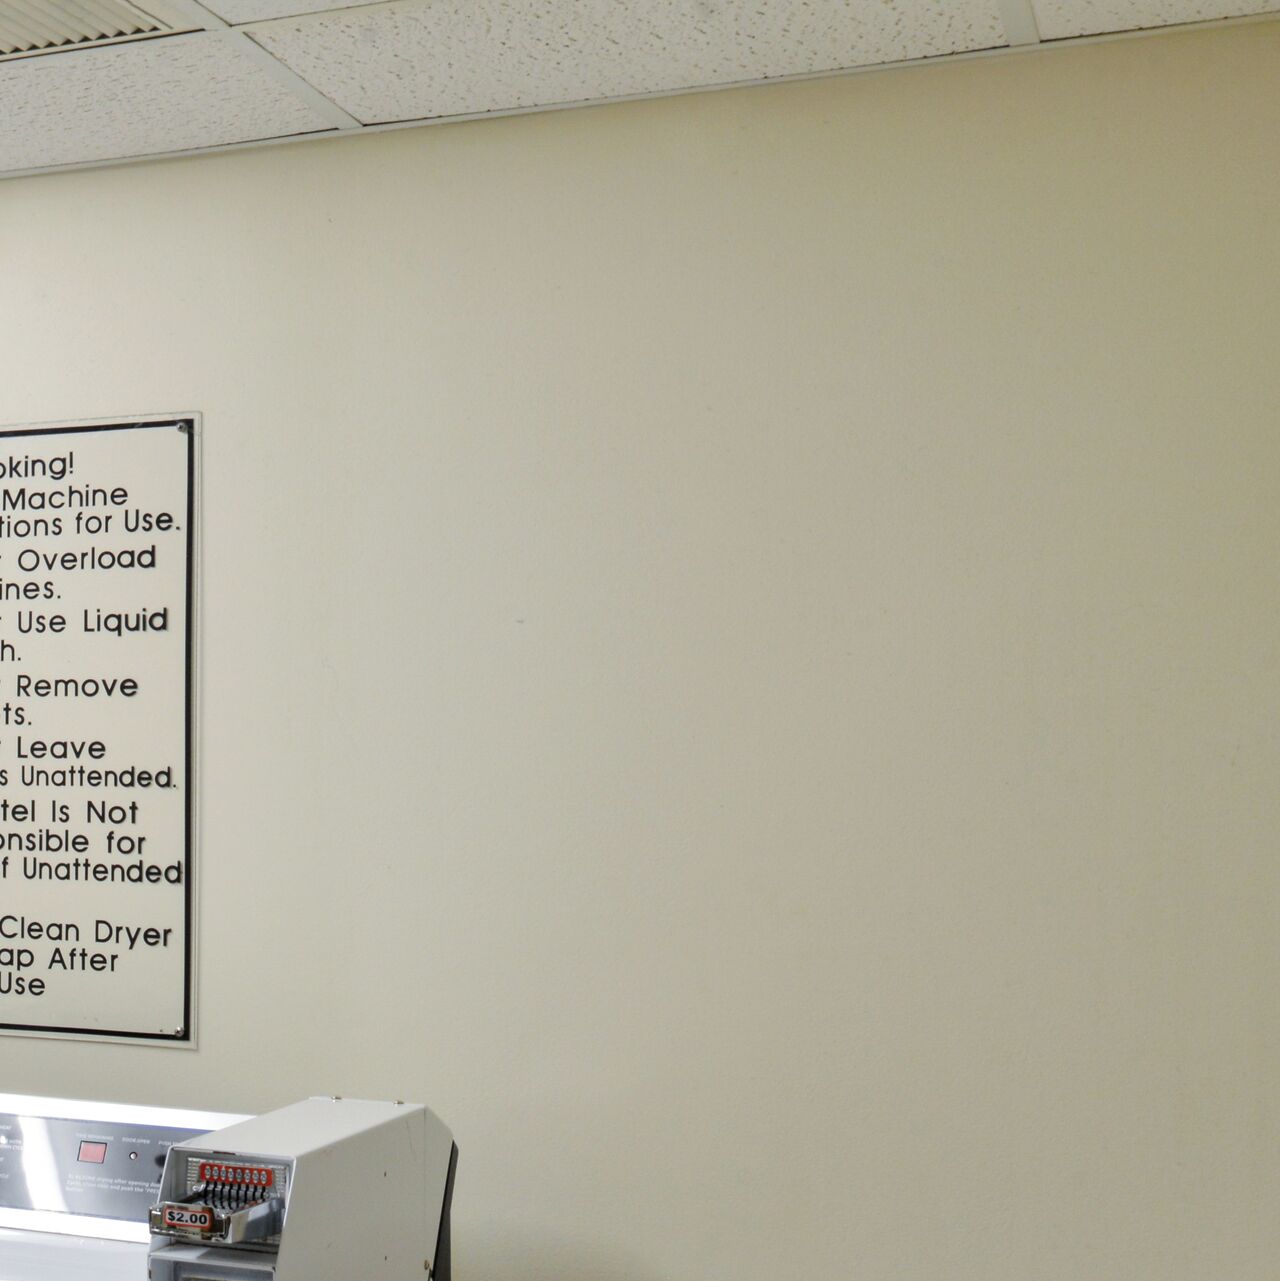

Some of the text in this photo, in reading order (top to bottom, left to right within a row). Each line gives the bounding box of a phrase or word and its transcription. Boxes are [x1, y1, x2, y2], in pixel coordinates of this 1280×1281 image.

[3, 485, 128, 511] Machine
[76, 512, 112, 534] for
[125, 509, 180, 532] Use.
[18, 545, 155, 571] Overload
[18, 611, 66, 633] Use
[84, 608, 168, 636] Liquid
[17, 675, 138, 697] Remove
[18, 736, 105, 759] Leave
[22, 766, 176, 788] Unattended.
[52, 800, 69, 823] Is
[87, 801, 138, 824] Not
[107, 831, 145, 854] for
[24, 857, 183, 884] Unattended
[0, 916, 79, 941] Clean
[95, 920, 172, 950] Dryer
[48, 948, 118, 971] After
[168, 1210, 208, 1225] $2.00
